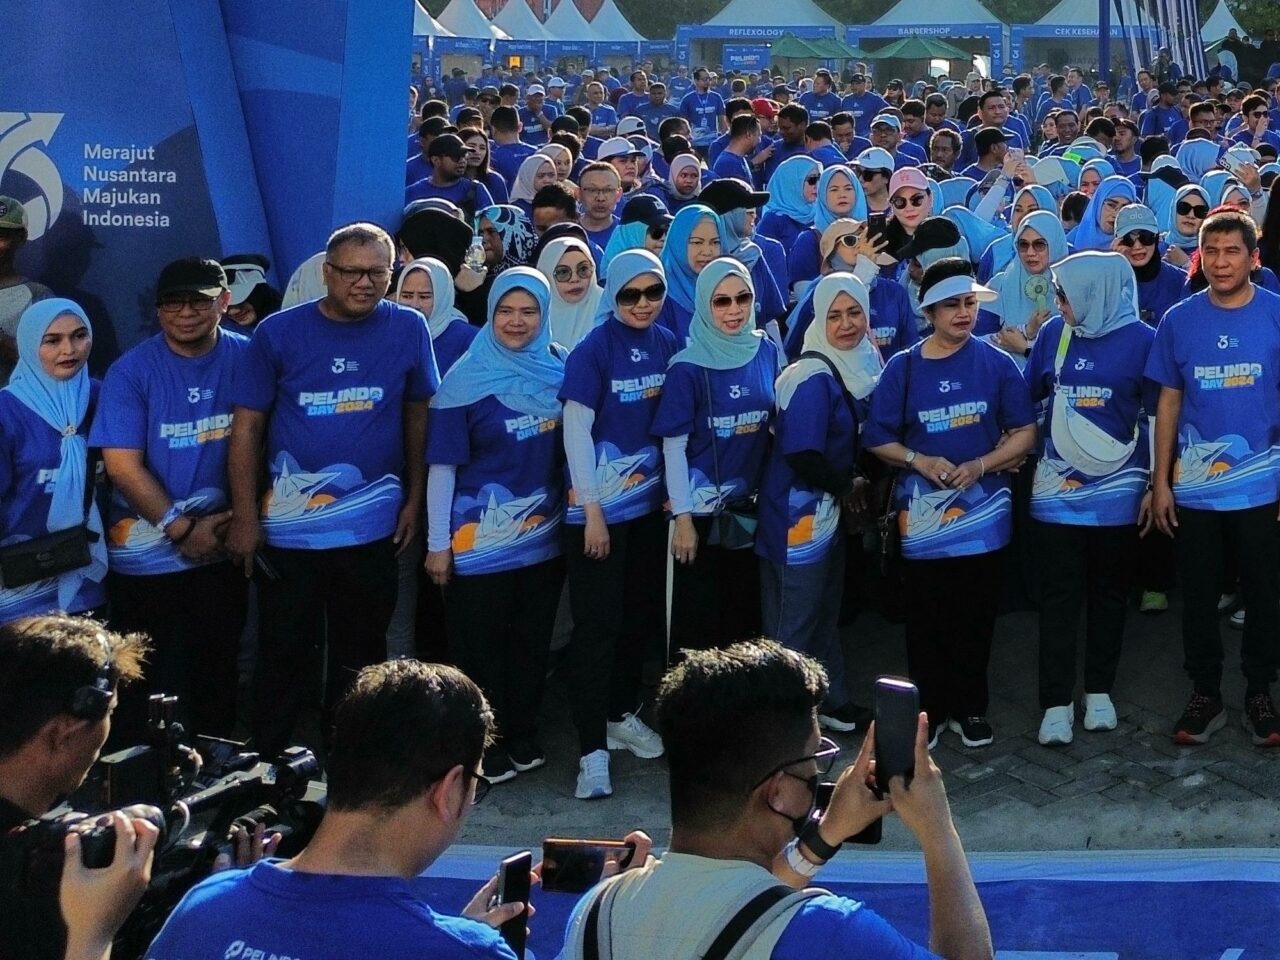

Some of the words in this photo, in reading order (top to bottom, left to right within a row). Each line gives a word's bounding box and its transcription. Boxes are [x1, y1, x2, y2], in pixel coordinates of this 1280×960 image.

[729, 28, 784, 36] REFLEXOLOGY
[1055, 28, 1071, 36] CEK
[84, 144, 155, 164] Merajut
[83, 166, 177, 183] Nusantara
[83, 188, 161, 207] Majukan
[83, 210, 170, 227] Indonesia
[1193, 362, 1262, 379] PELINDO
[611, 373, 667, 394] PELIND
[1061, 384, 1112, 399] ELINDO
[299, 387, 385, 406] PELINDO
[918, 401, 987, 423] PELINDO
